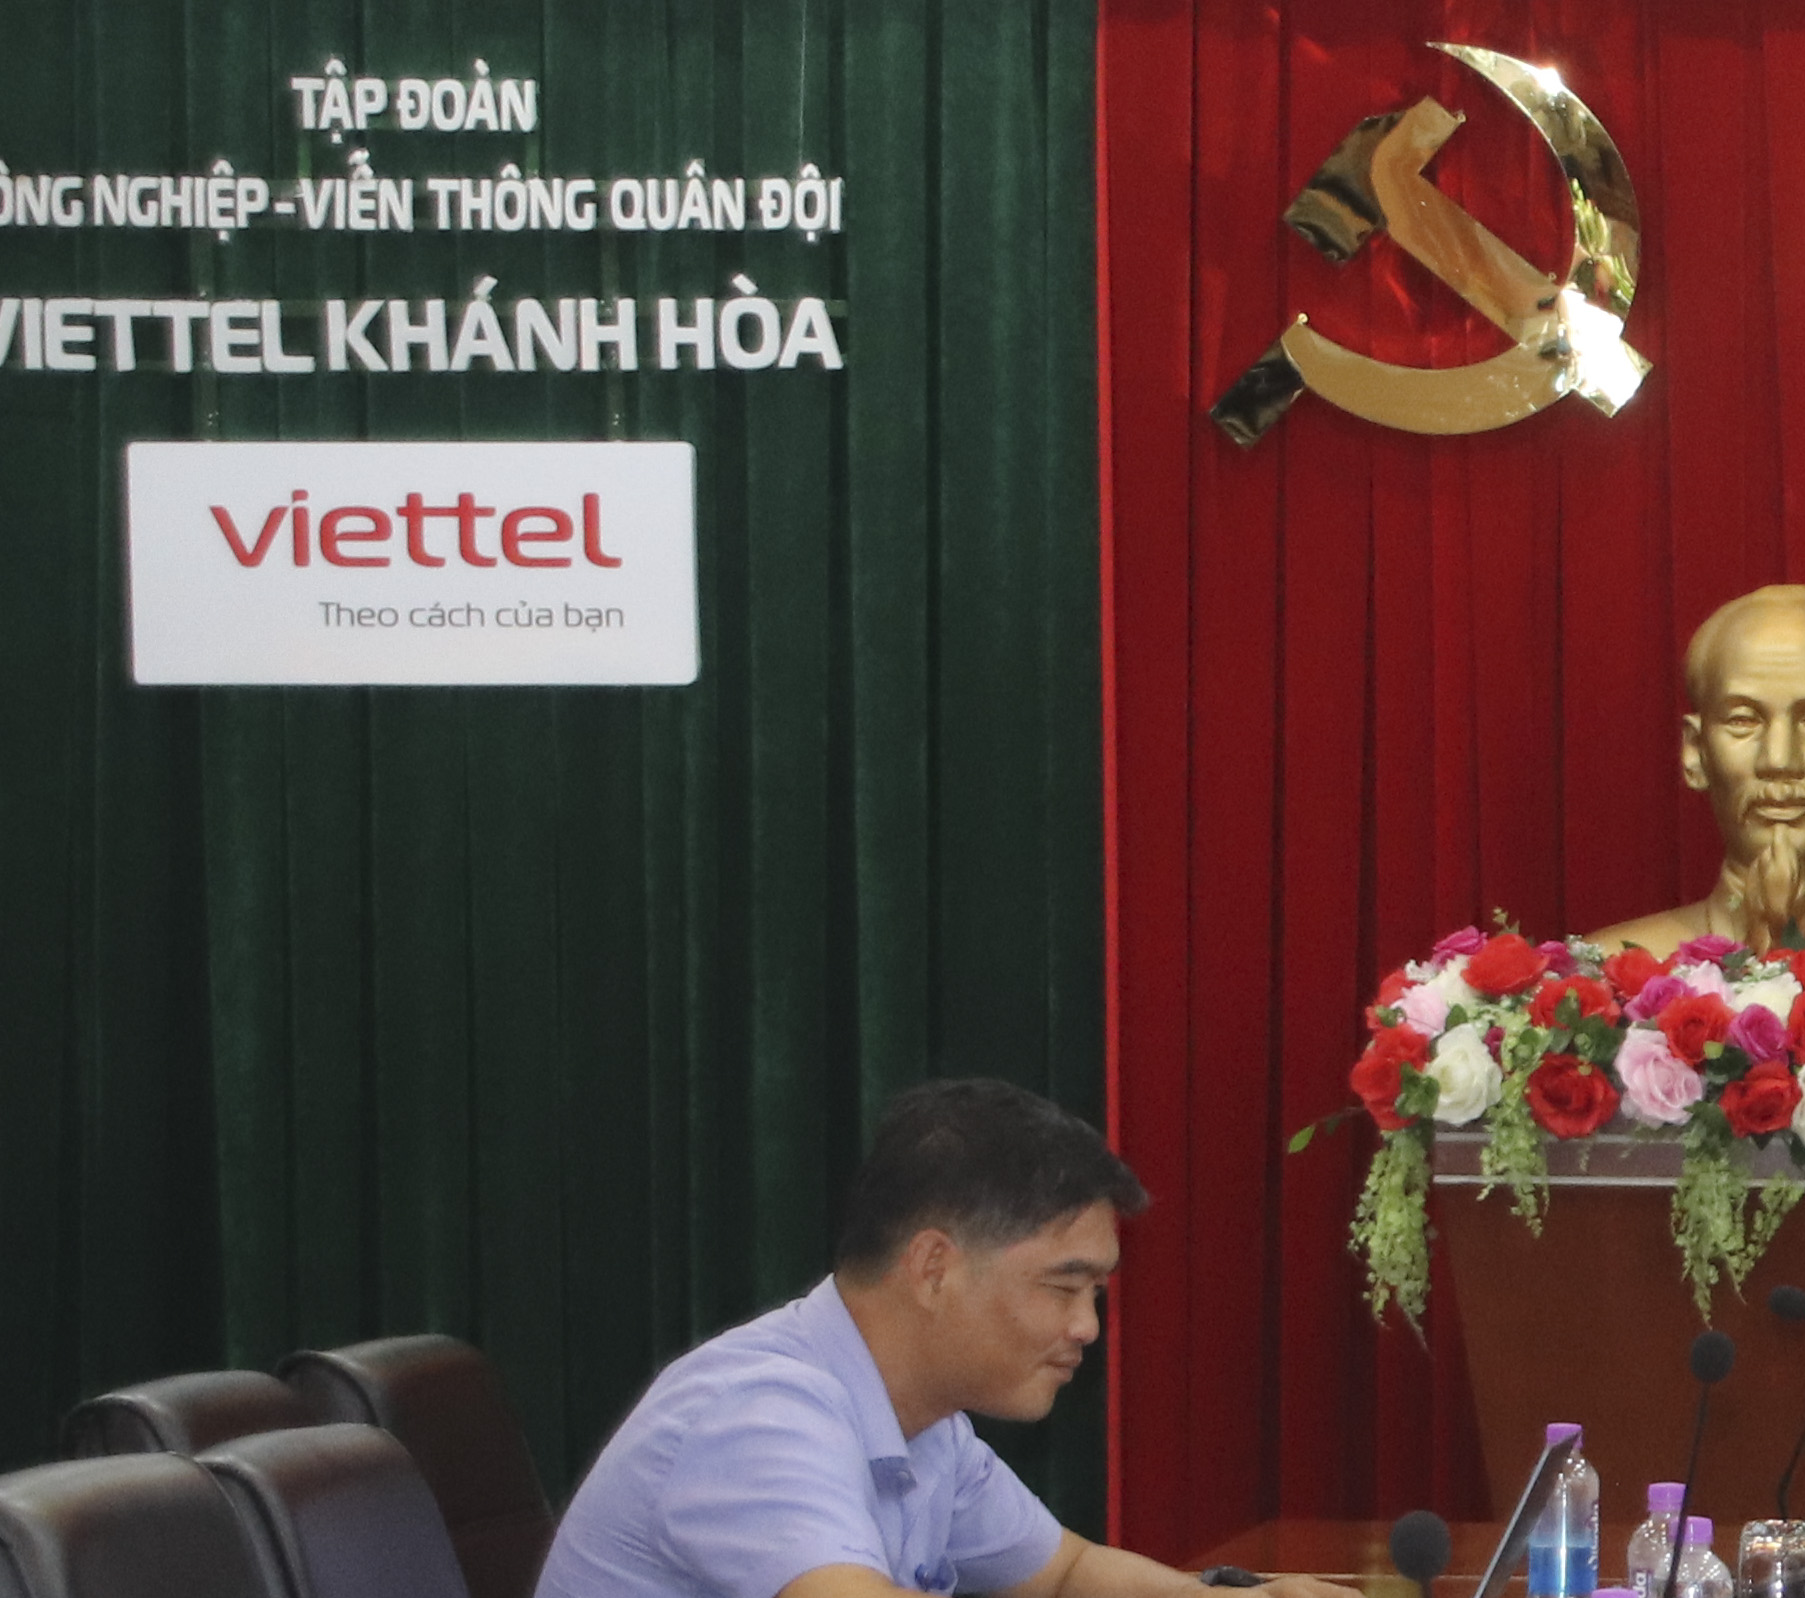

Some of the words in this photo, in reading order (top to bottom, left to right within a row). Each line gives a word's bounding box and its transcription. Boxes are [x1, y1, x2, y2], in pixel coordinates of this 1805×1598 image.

[291, 57, 388, 144] TẬP
[396, 58, 537, 132] ĐOÀN
[426, 163, 597, 231] THÔNG
[609, 158, 745, 232] QUÂN
[757, 162, 844, 242] ĐỘI
[325, 274, 638, 373] KHÁNH
[657, 273, 844, 371] HÒA
[210, 489, 623, 569] viettel
[319, 601, 399, 629] Theo
[408, 601, 486, 629] cách
[495, 599, 555, 629] của
[563, 601, 625, 634] bạn
